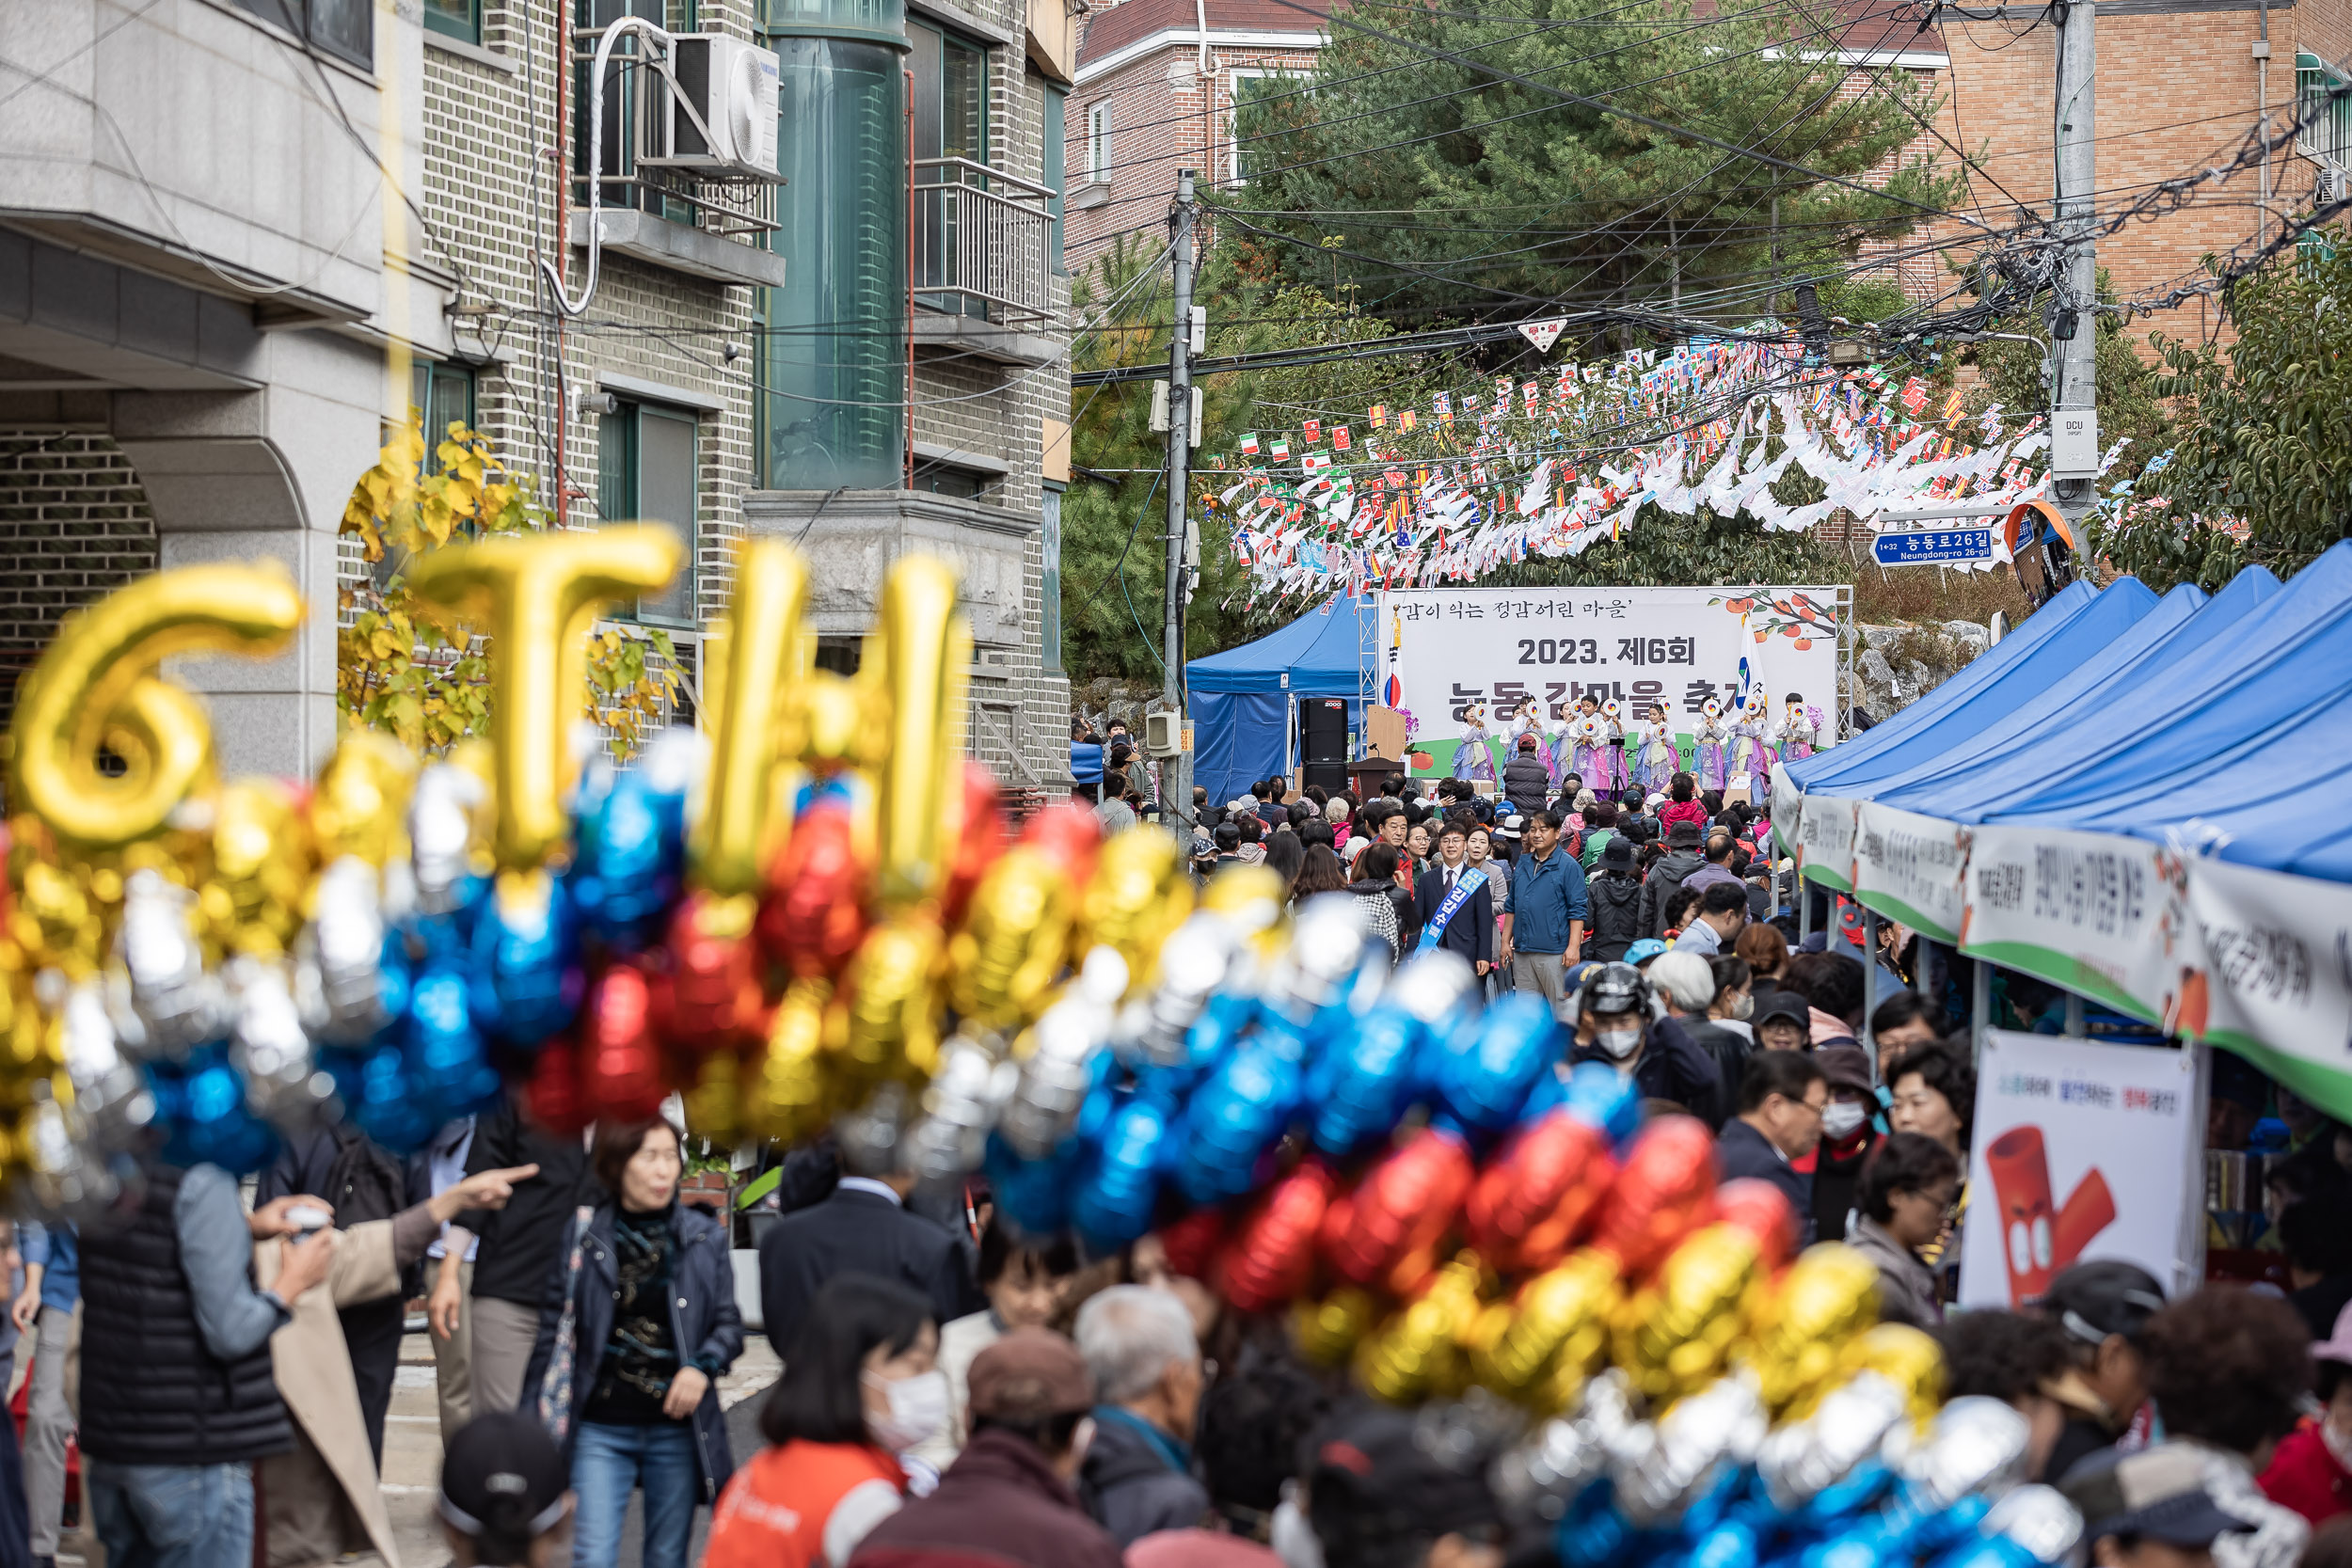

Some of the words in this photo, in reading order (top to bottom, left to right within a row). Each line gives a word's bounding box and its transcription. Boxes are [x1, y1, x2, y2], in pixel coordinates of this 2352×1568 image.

[2066, 420, 2083, 430] DCU
[1906, 531, 1988, 551] 능동로26길
[1900, 550, 1963, 561] Neungdong-ro
[1964, 547, 1990, 557] 26-gil
[1449, 600, 1485, 619] 익는
[1492, 600, 1574, 619] 정감어린
[1518, 639, 1607, 665] 2023.
[1616, 637, 1695, 666] 제6회
[1435, 886, 1468, 926] 김갑수
